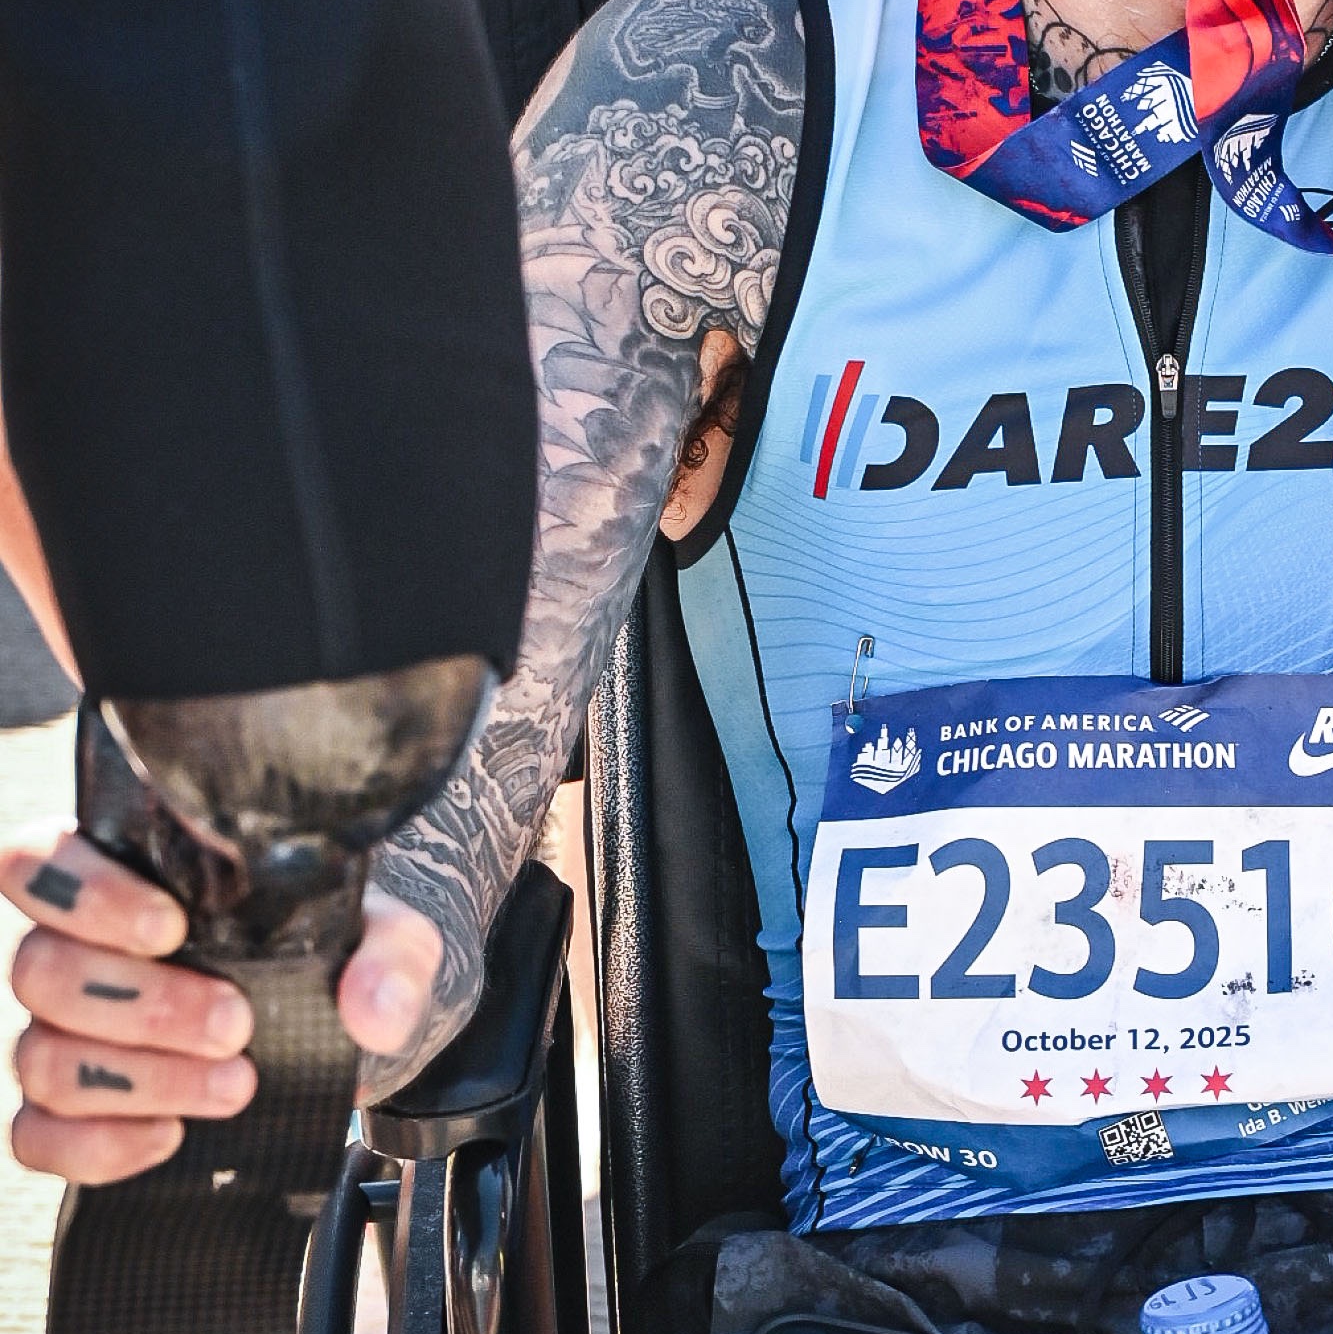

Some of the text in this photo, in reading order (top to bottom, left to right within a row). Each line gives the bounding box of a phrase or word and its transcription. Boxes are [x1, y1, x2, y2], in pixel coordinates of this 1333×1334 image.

[1082, 103, 1140, 180] CHICAGO
[1095, 93, 1152, 173] MARATHON
[1232, 156, 1272, 208] MARATHON
[1243, 170, 1277, 218] CHICAGO
[940, 714, 1154, 741] BANK OF AMERICA
[937, 741, 1236, 777] CHICAGO MARATHON
[1001, 1024, 1252, 1055] October 12, 2025
[1238, 1109, 1288, 1138] Ida B.
[959, 1149, 998, 1169] 30
